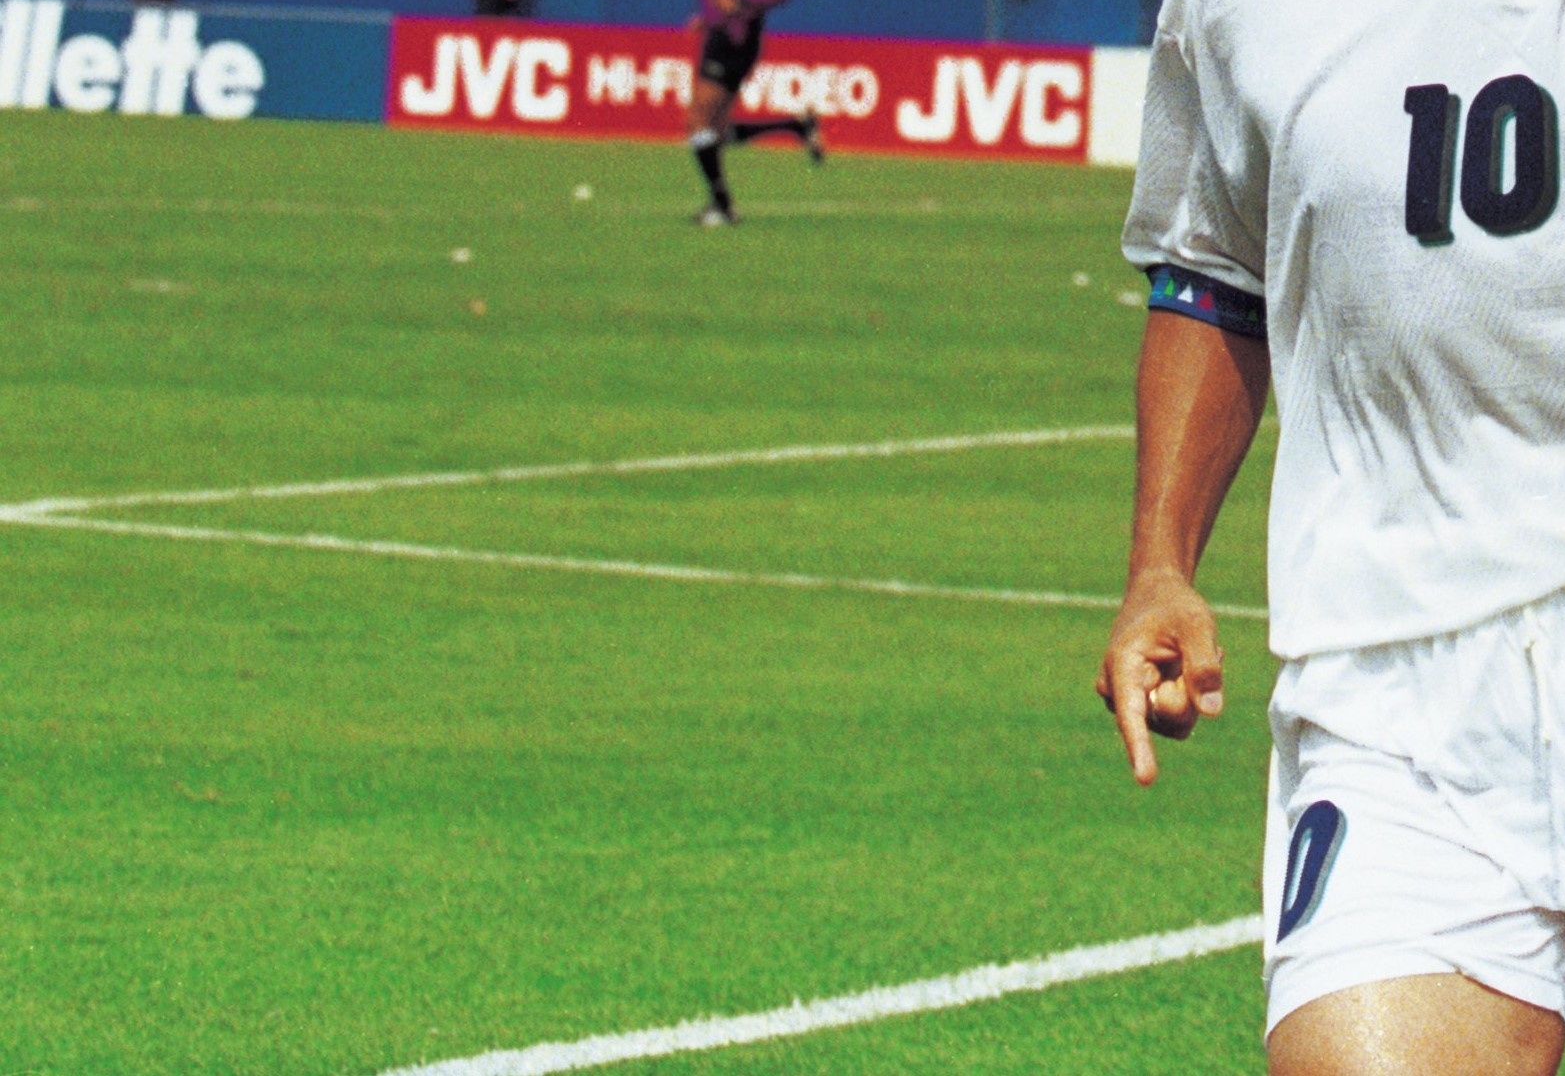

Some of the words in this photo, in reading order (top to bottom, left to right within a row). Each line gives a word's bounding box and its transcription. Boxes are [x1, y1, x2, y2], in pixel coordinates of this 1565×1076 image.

[400, 34, 571, 121] JVC
[739, 63, 879, 117] VIDEO
[897, 55, 1083, 147] JVC
[1404, 74, 1560, 247] 10
